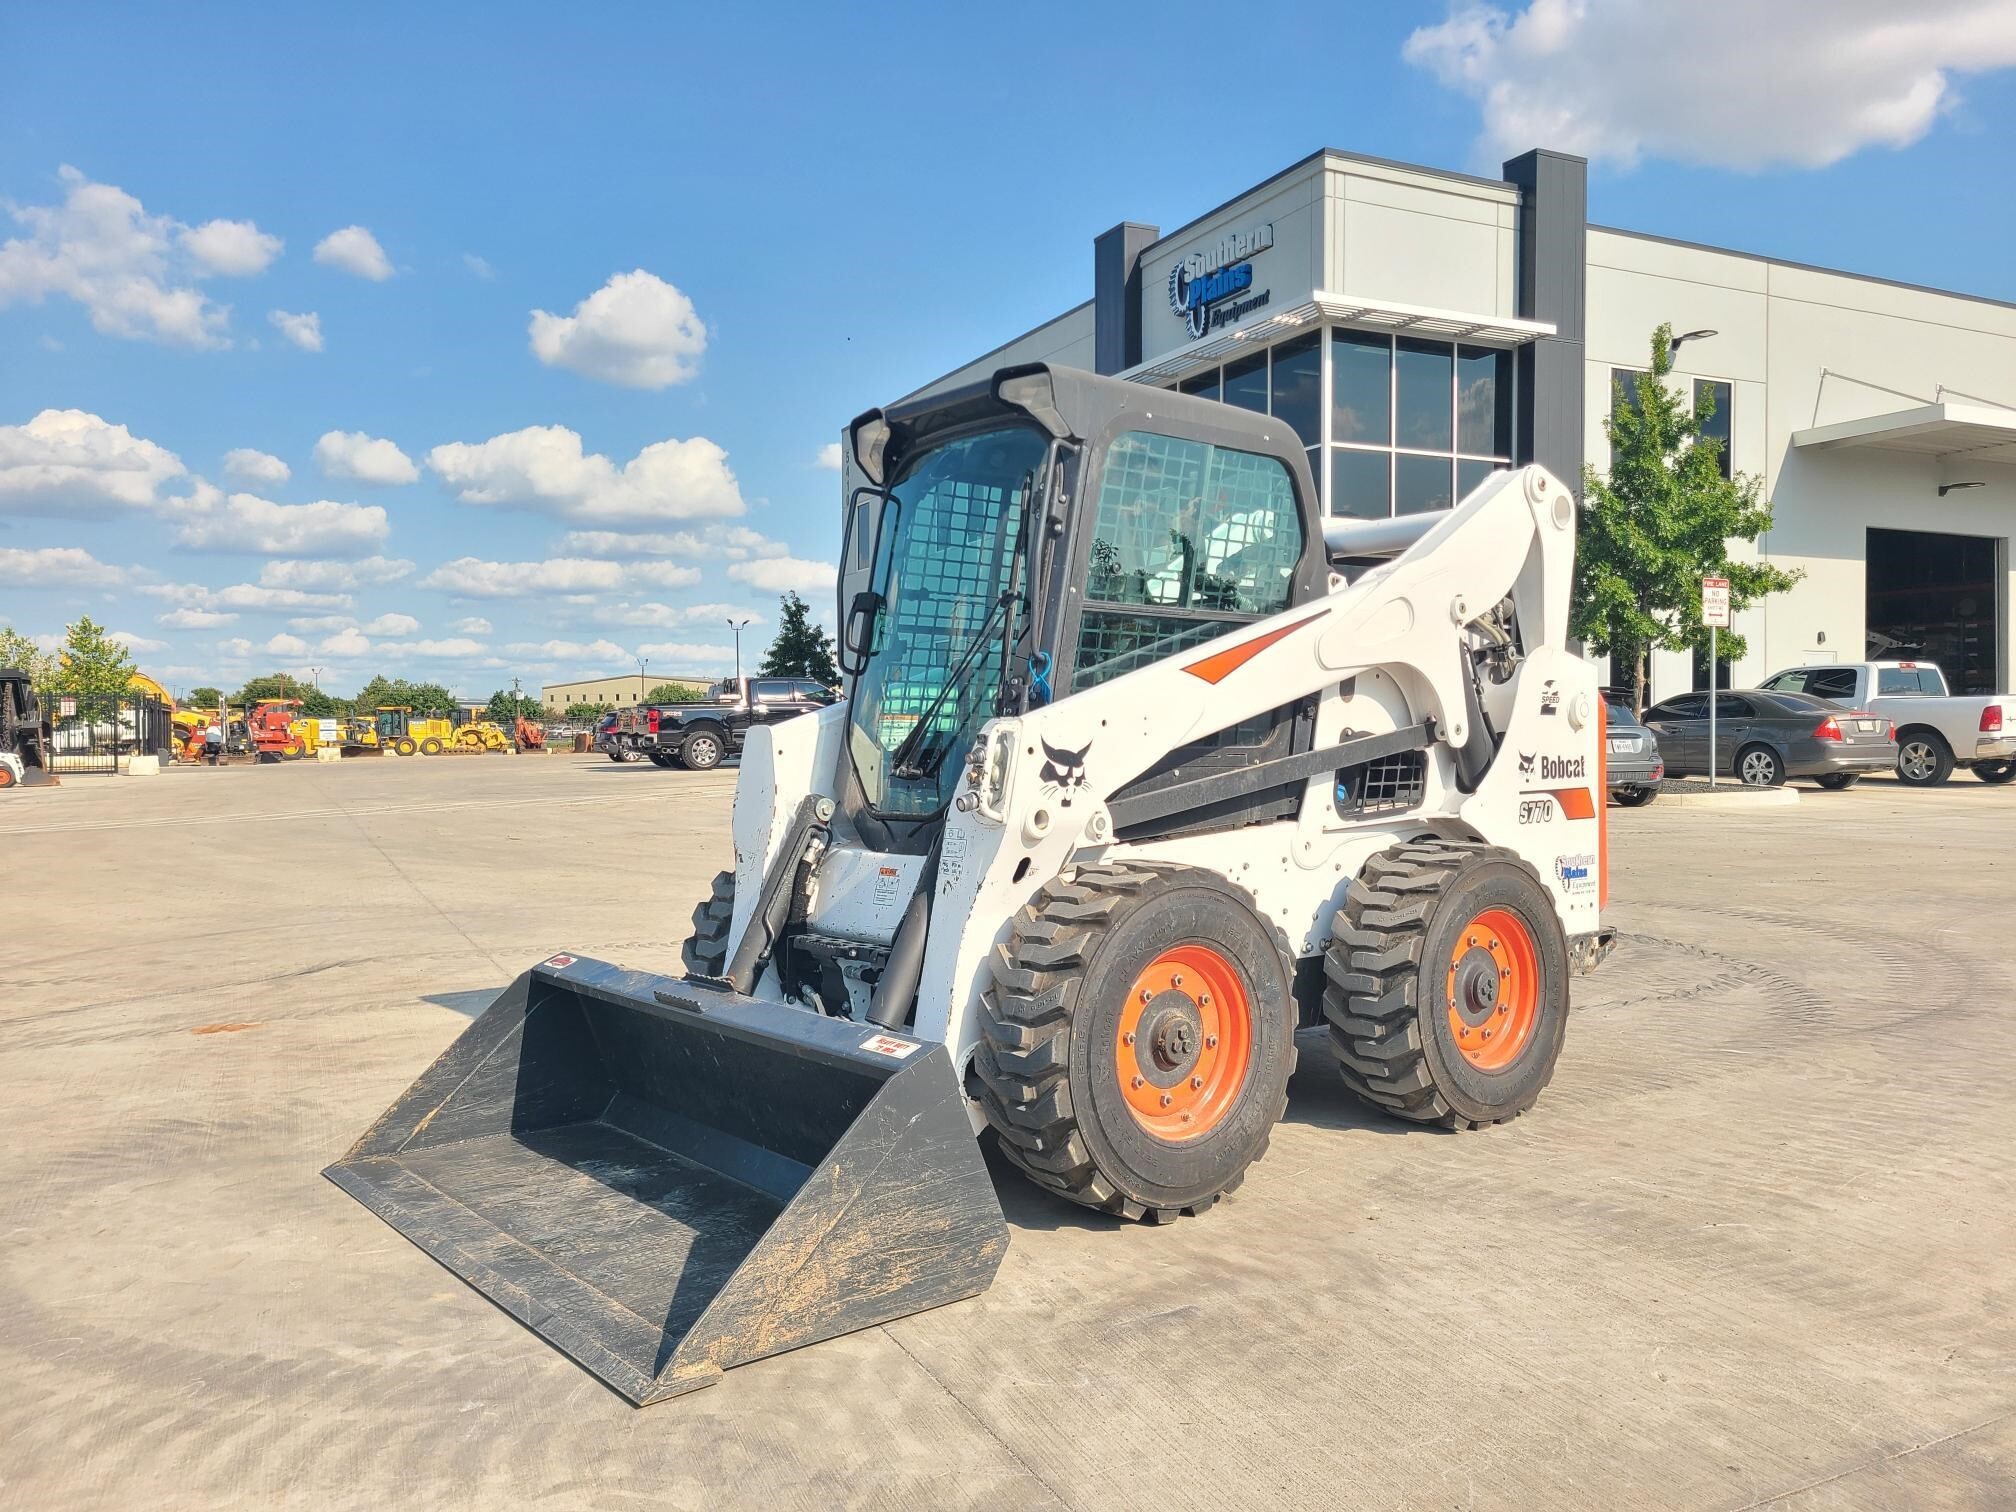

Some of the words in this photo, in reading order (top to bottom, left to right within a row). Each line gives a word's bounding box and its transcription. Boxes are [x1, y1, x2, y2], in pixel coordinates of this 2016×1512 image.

[1183, 223, 1273, 283] Southern
[1210, 288, 1270, 328] Equipment
[1704, 597, 1727, 605] PARKING
[1541, 695, 1560, 704] SPEED
[1541, 755, 1585, 780] Bobcat
[1519, 800, 1553, 824] S770
[1561, 853, 1596, 868] Southern
[1563, 866, 1588, 880] Plains
